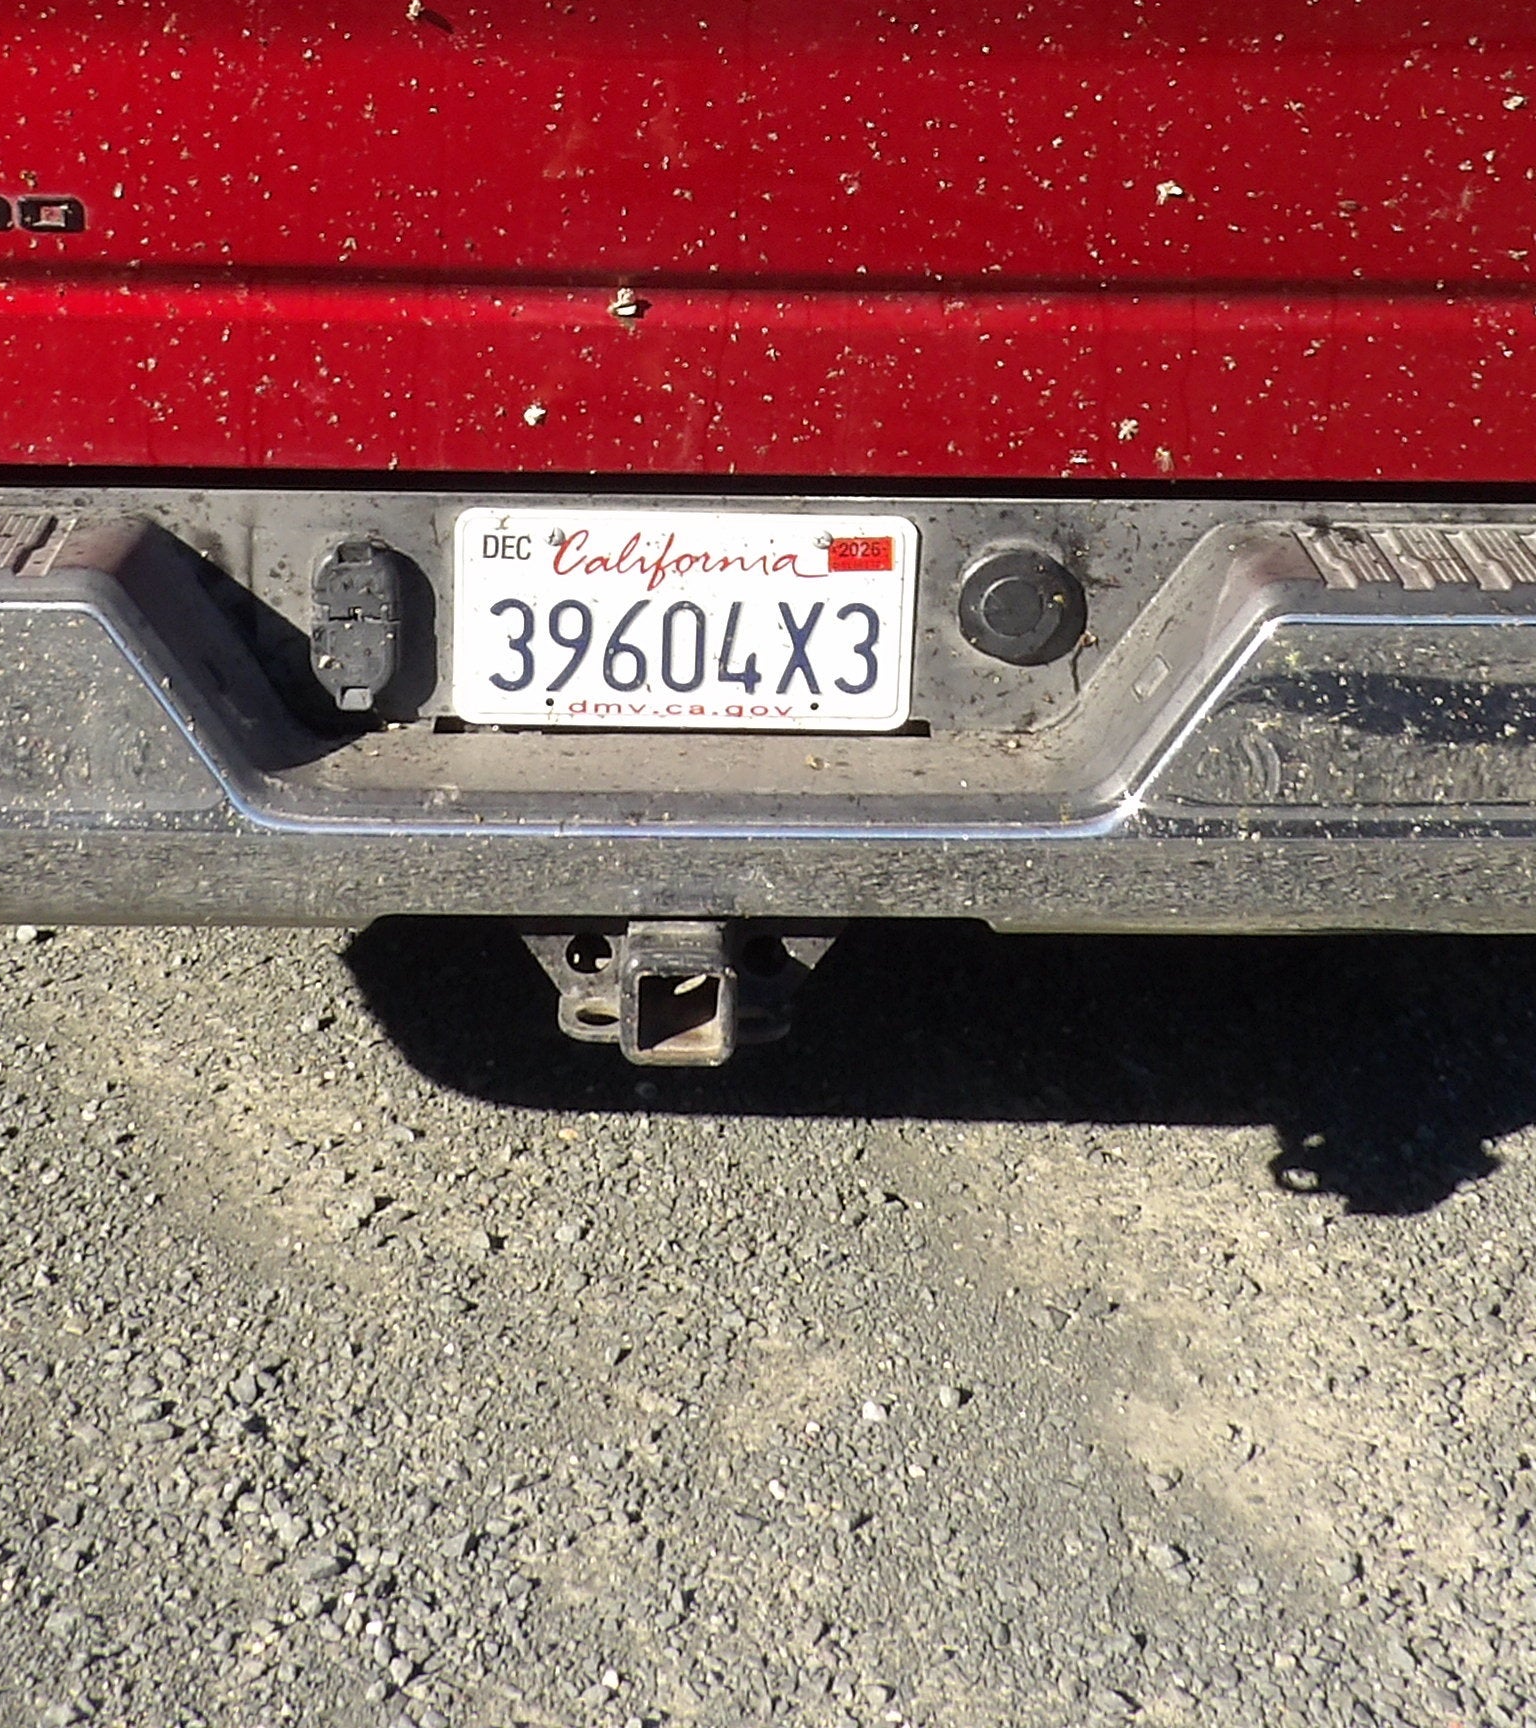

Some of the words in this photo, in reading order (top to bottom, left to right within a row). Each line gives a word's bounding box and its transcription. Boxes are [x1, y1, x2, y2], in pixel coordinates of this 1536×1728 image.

[482, 534, 532, 561] DEC
[552, 529, 829, 591] California
[488, 597, 881, 695] 39604X3
[568, 699, 793, 718] dmv.ca.gov
